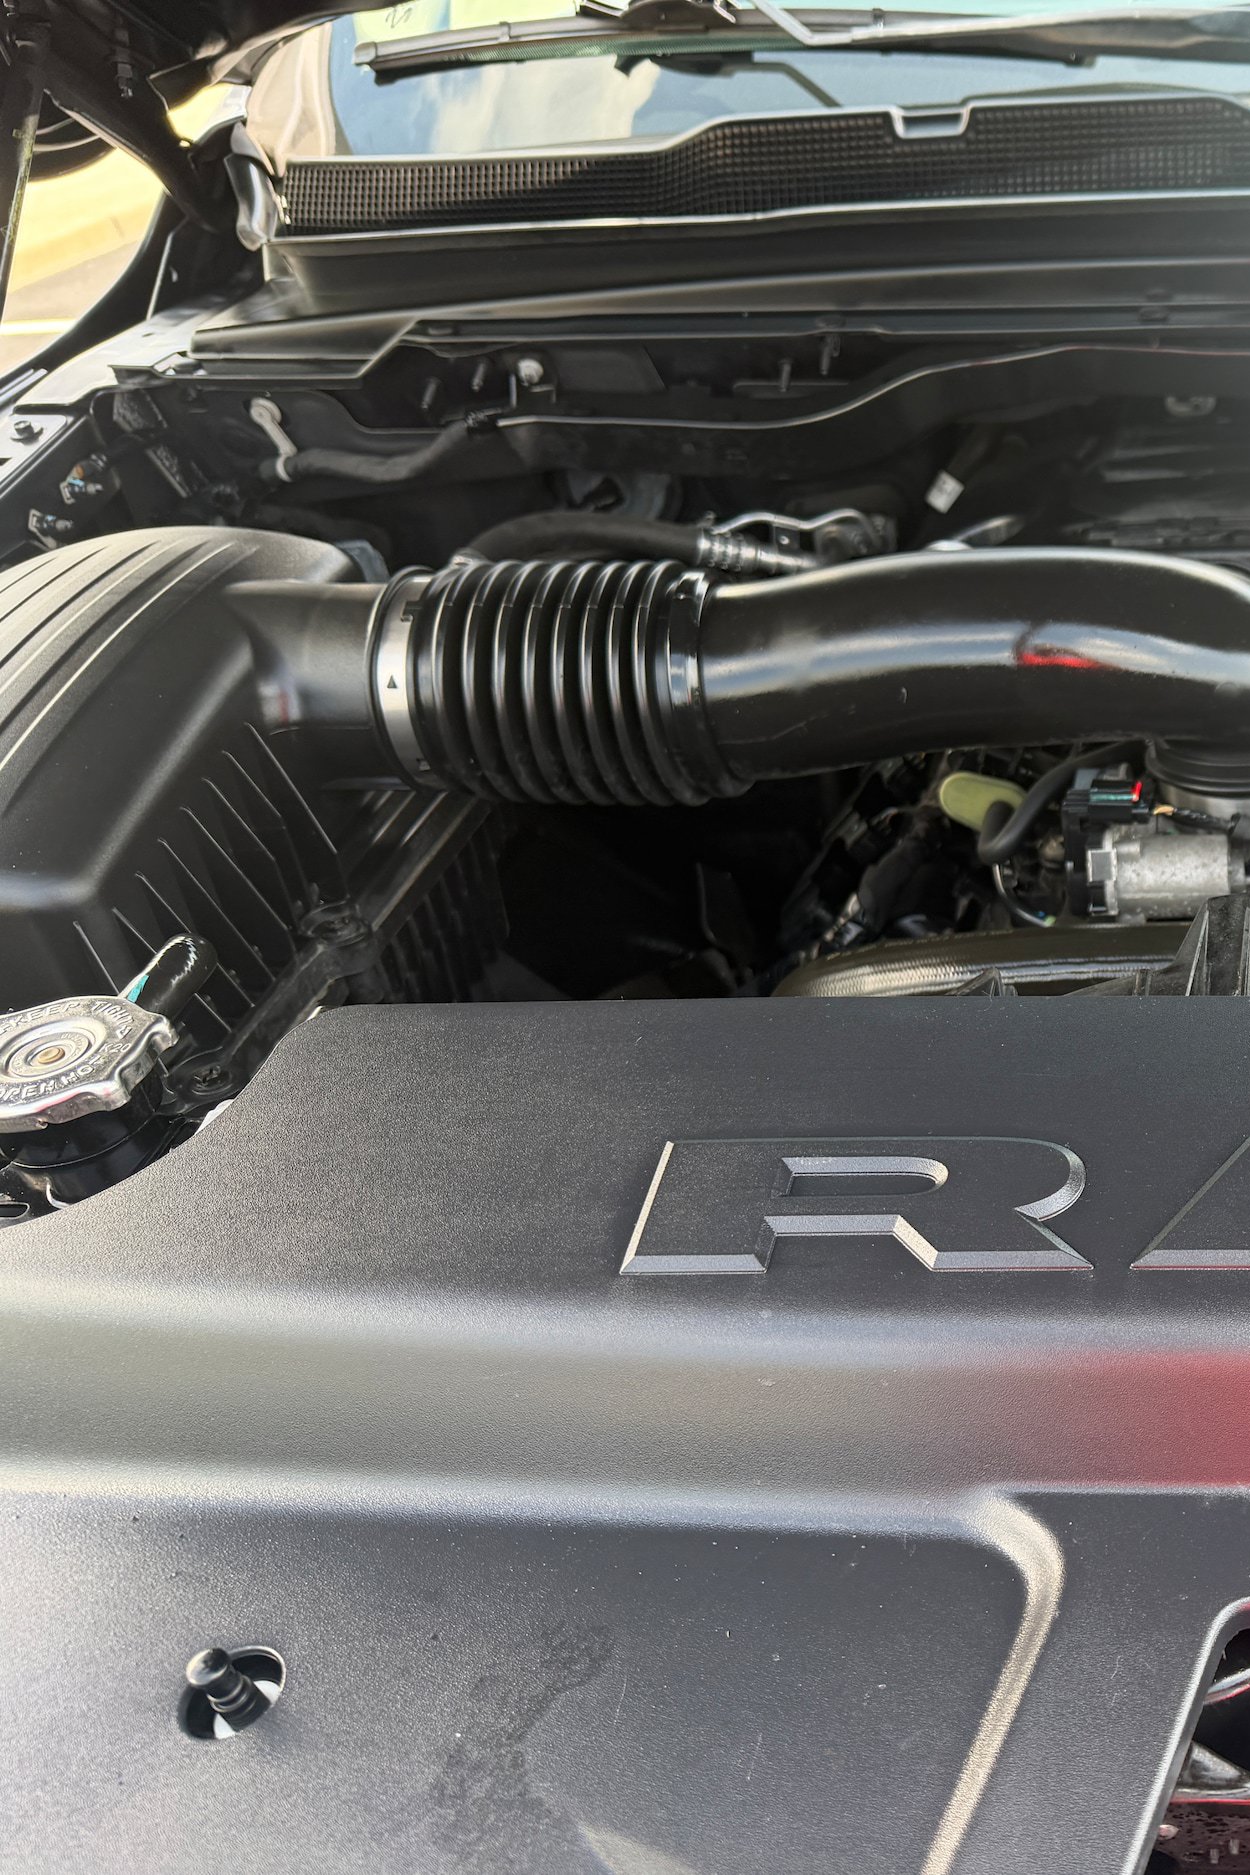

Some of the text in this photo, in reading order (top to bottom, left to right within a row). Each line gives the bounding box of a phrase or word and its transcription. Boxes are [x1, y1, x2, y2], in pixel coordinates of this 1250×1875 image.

[9, 1000, 134, 1027] KEEP TIGHT
[98, 1042, 132, 1054] K20
[0, 1054, 104, 1102] PEN HOT
